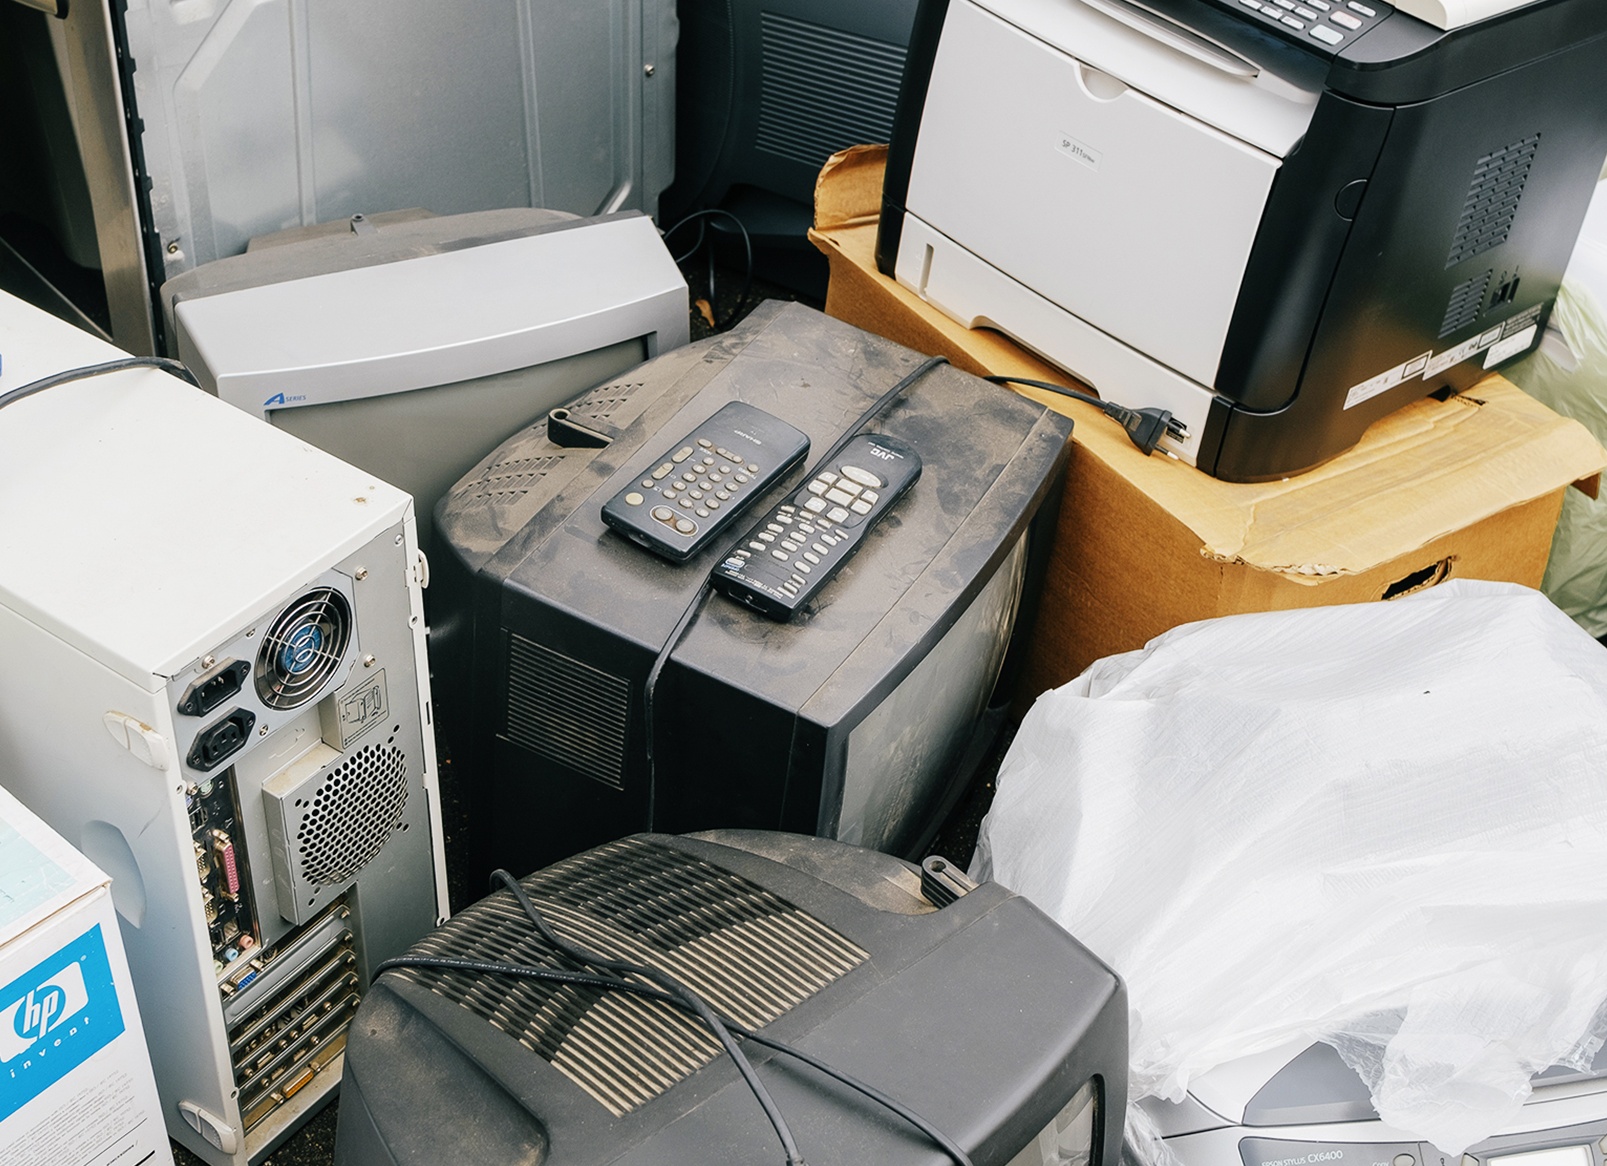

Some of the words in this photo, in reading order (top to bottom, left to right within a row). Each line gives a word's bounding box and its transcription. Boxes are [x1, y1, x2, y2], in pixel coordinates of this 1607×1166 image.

[1062, 139, 1071, 148] SP
[263, 392, 285, 406] A
[869, 447, 895, 460] JVC
[23, 989, 59, 1039] hp
[10, 1016, 89, 1078] invent
[1283, 1157, 1306, 1166] STYLUS
[1307, 1150, 1343, 1163] CX6400
